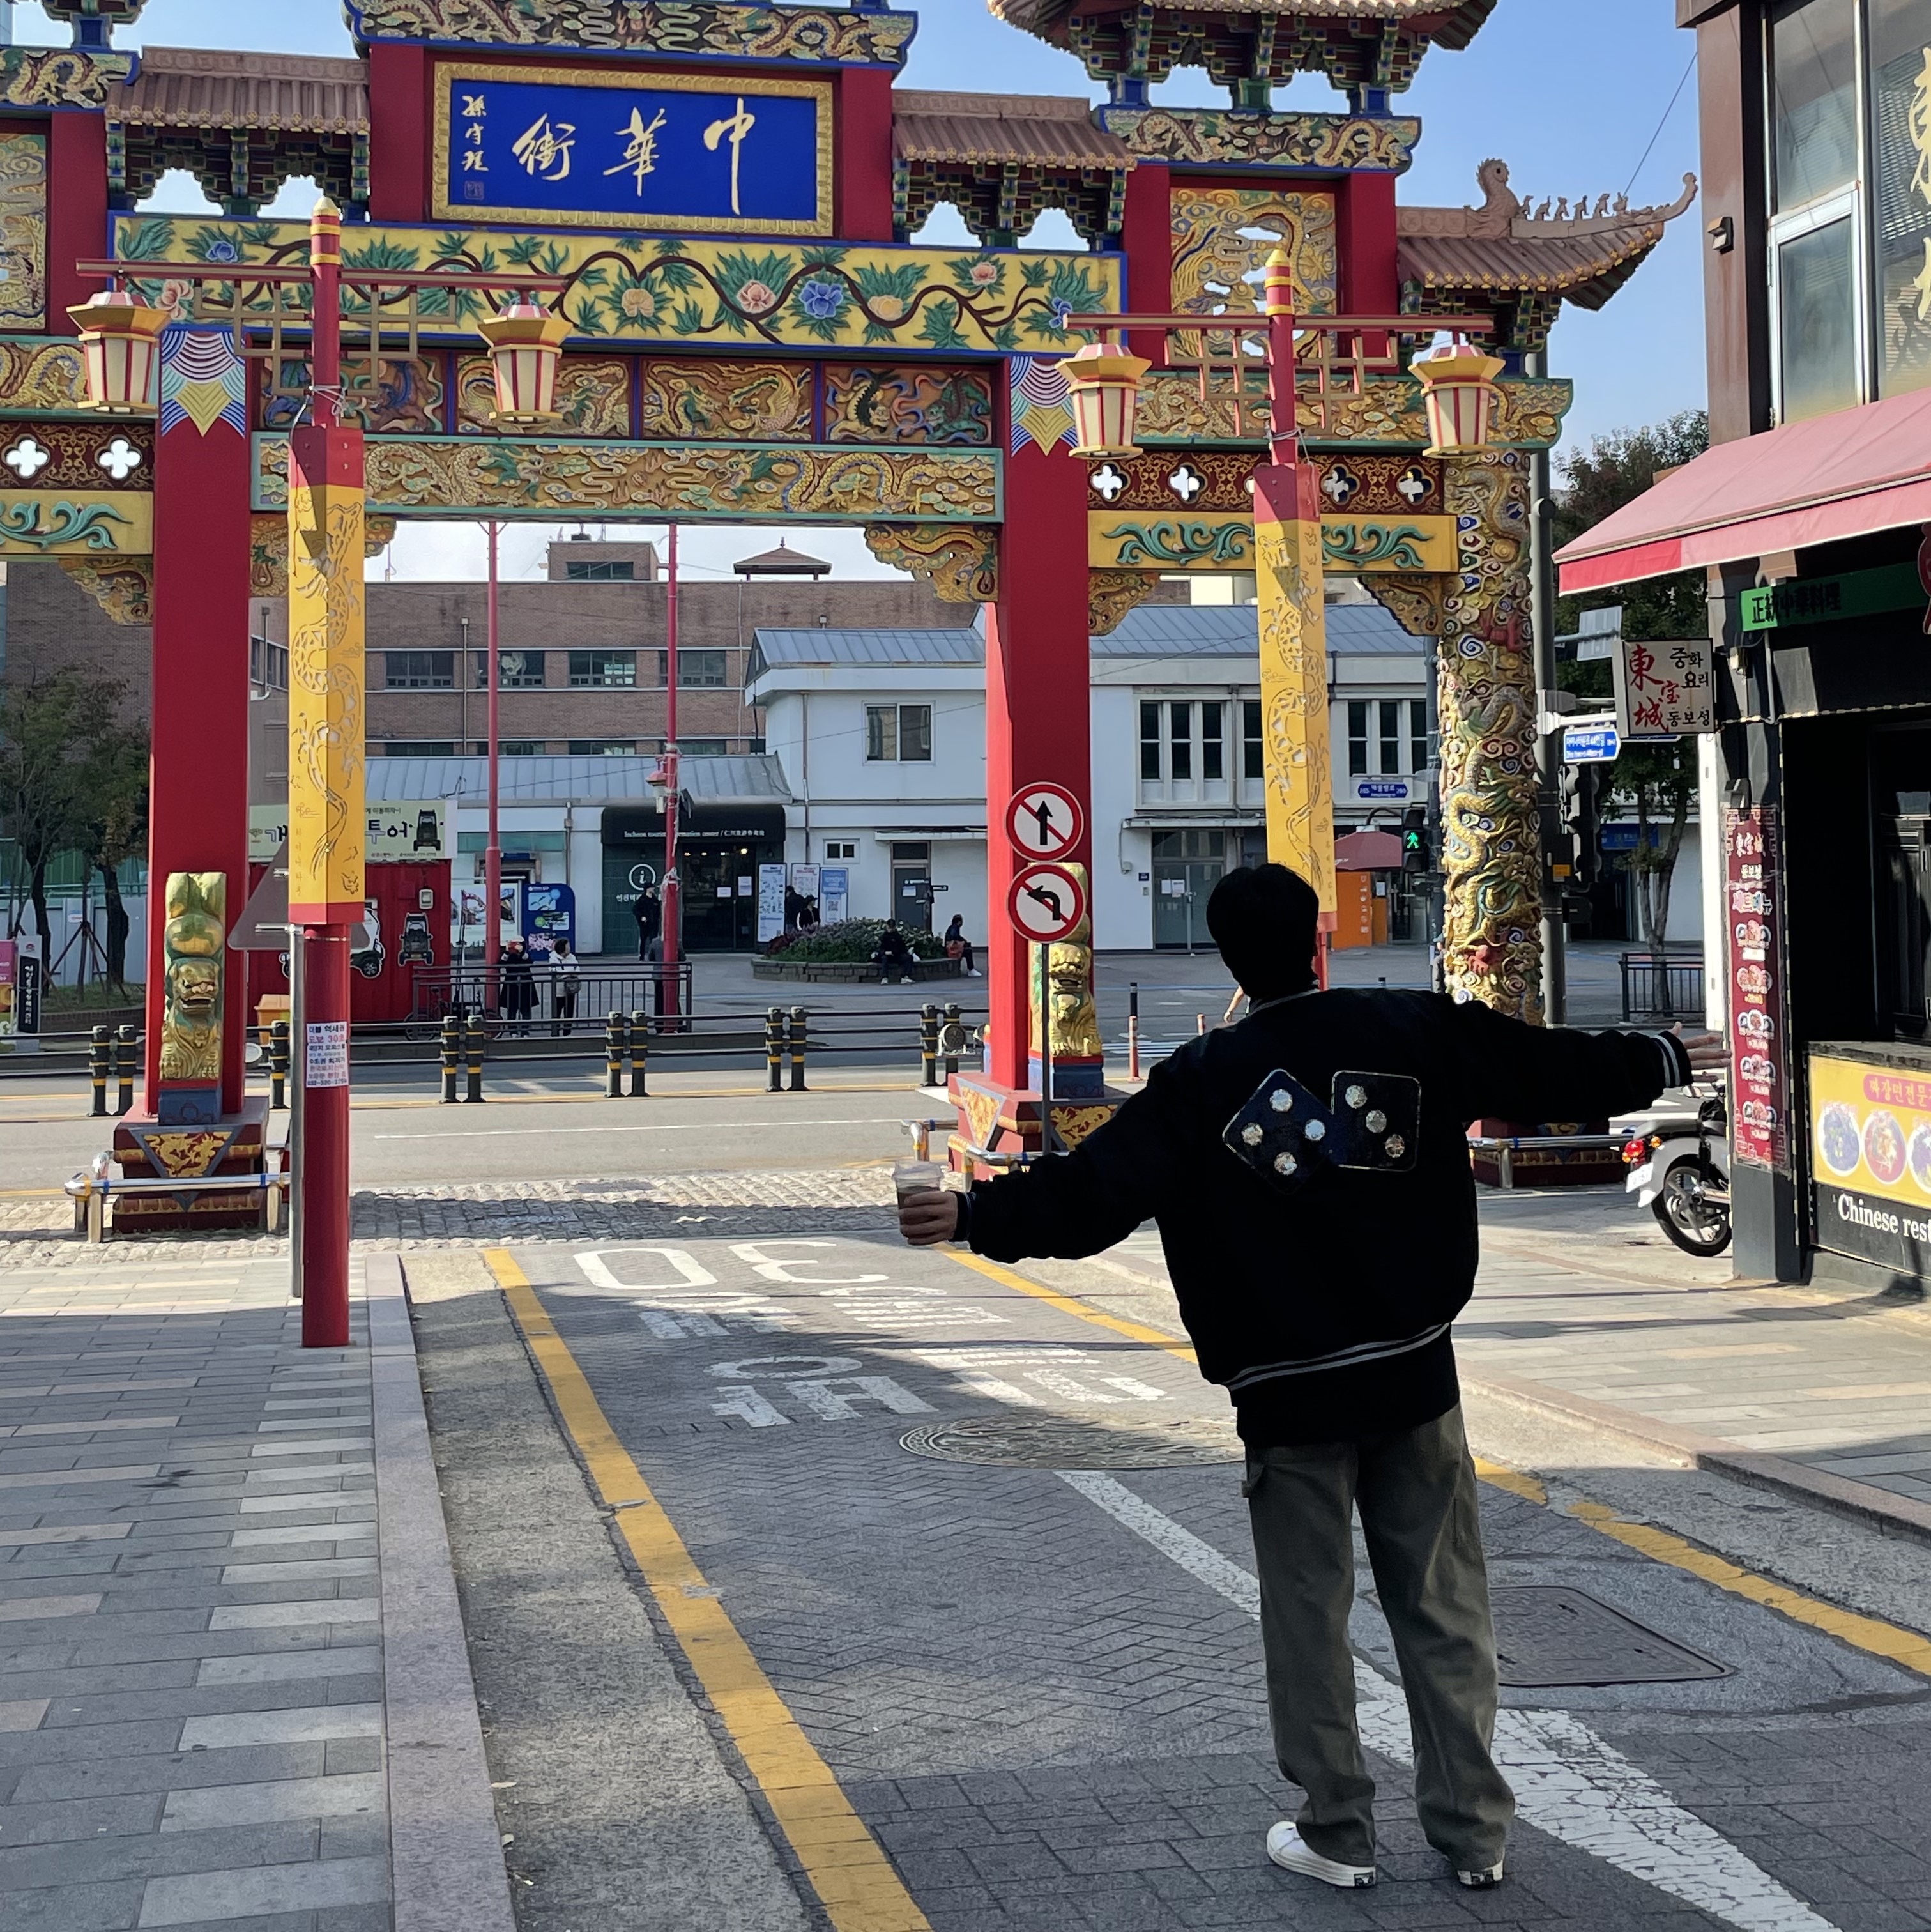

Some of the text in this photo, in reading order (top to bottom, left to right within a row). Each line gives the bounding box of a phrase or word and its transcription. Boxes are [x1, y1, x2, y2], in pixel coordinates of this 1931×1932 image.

[1670, 647, 1704, 668] 중화
[1681, 671, 1709, 689] 요리
[1667, 710, 1710, 727] 동보성
[1741, 864, 1762, 879] 동보성
[1838, 1193, 1900, 1234] Chinese
